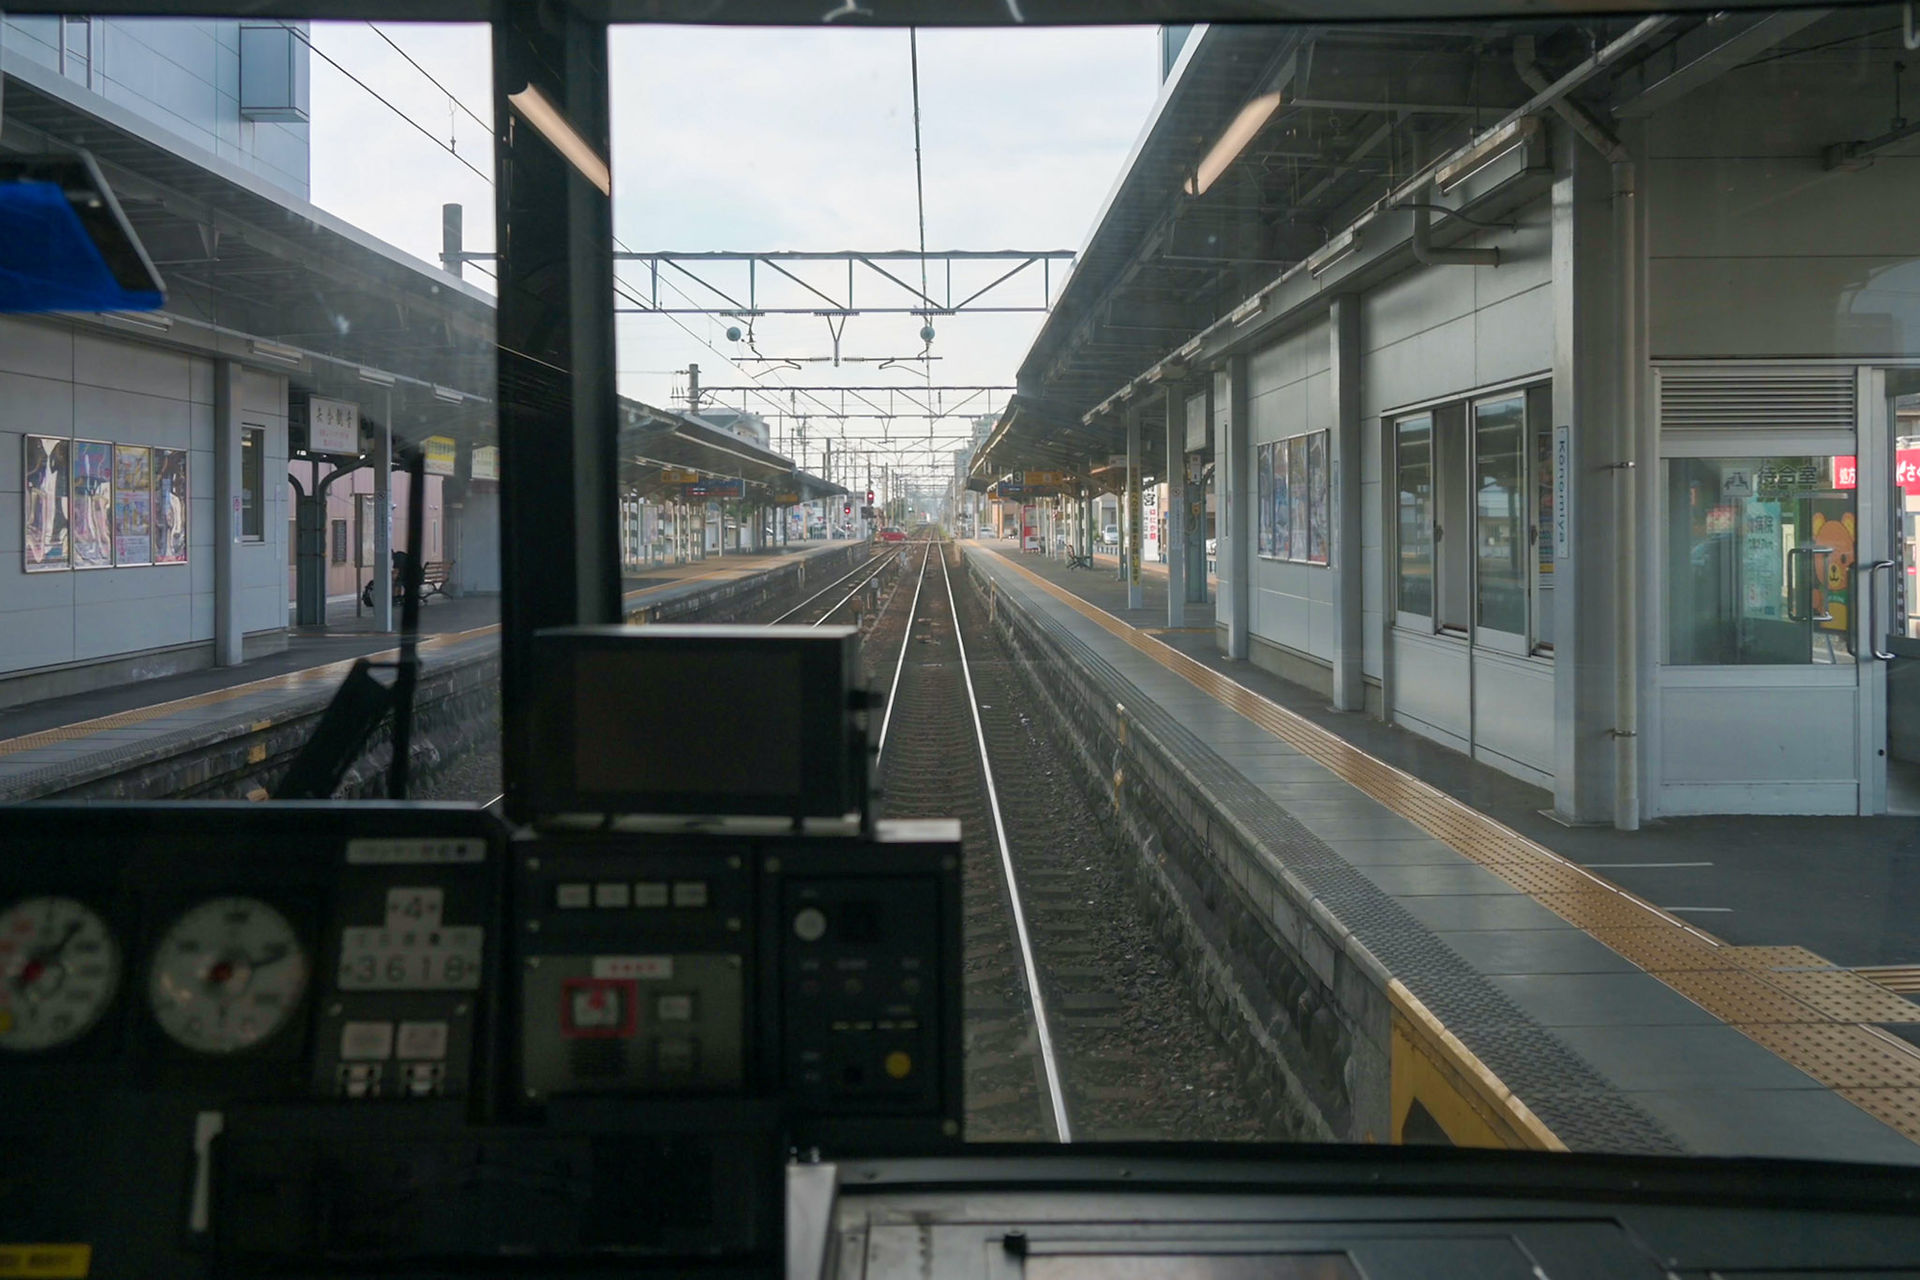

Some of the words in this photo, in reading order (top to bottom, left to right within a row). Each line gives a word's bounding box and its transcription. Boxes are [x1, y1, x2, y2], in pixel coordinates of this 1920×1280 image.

[1759, 465, 1818, 490] 待合室
[404, 896, 423, 920] 4
[355, 952, 467, 985] 3618
